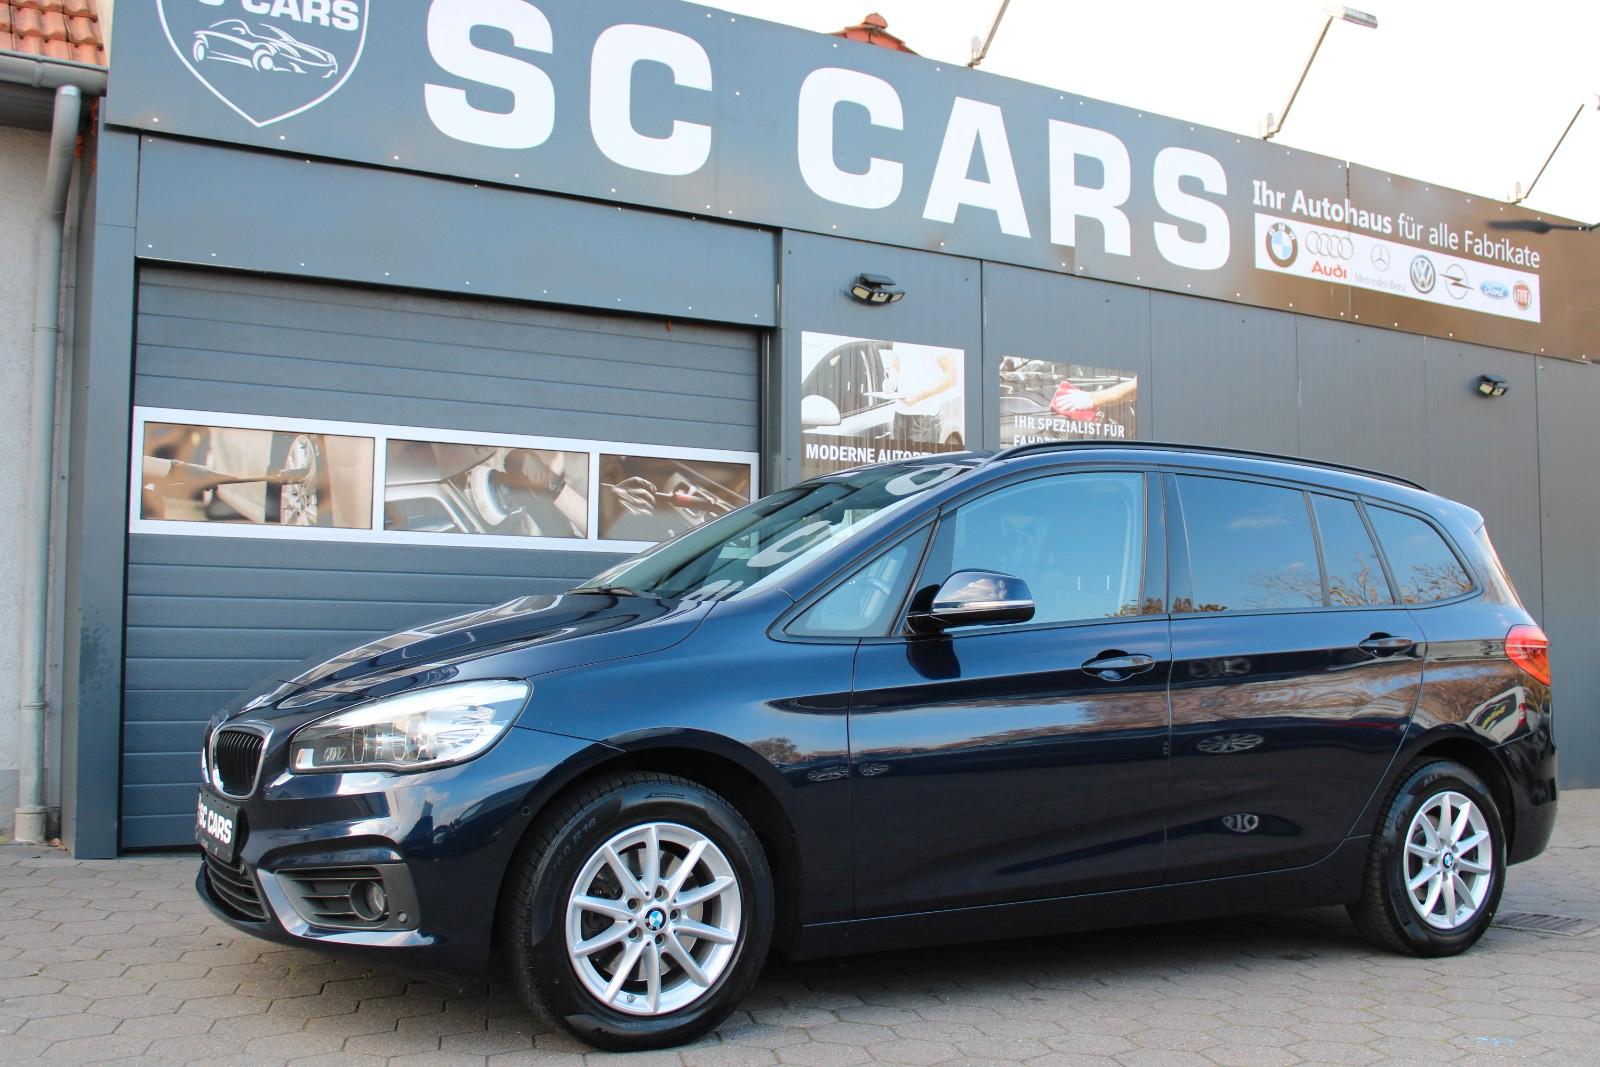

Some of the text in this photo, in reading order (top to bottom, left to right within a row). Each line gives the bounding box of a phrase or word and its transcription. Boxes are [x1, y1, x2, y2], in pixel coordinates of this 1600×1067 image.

[425, 0, 1231, 272] SC CARS
[1252, 180, 1540, 269] Ihr Autohaus für alle Fabrikate
[1311, 260, 1348, 280] Audi
[1014, 415, 1125, 438] IHR SPEZIALIST FÜR
[806, 443, 875, 463] MODERNE
[208, 810, 232, 844] CARS
